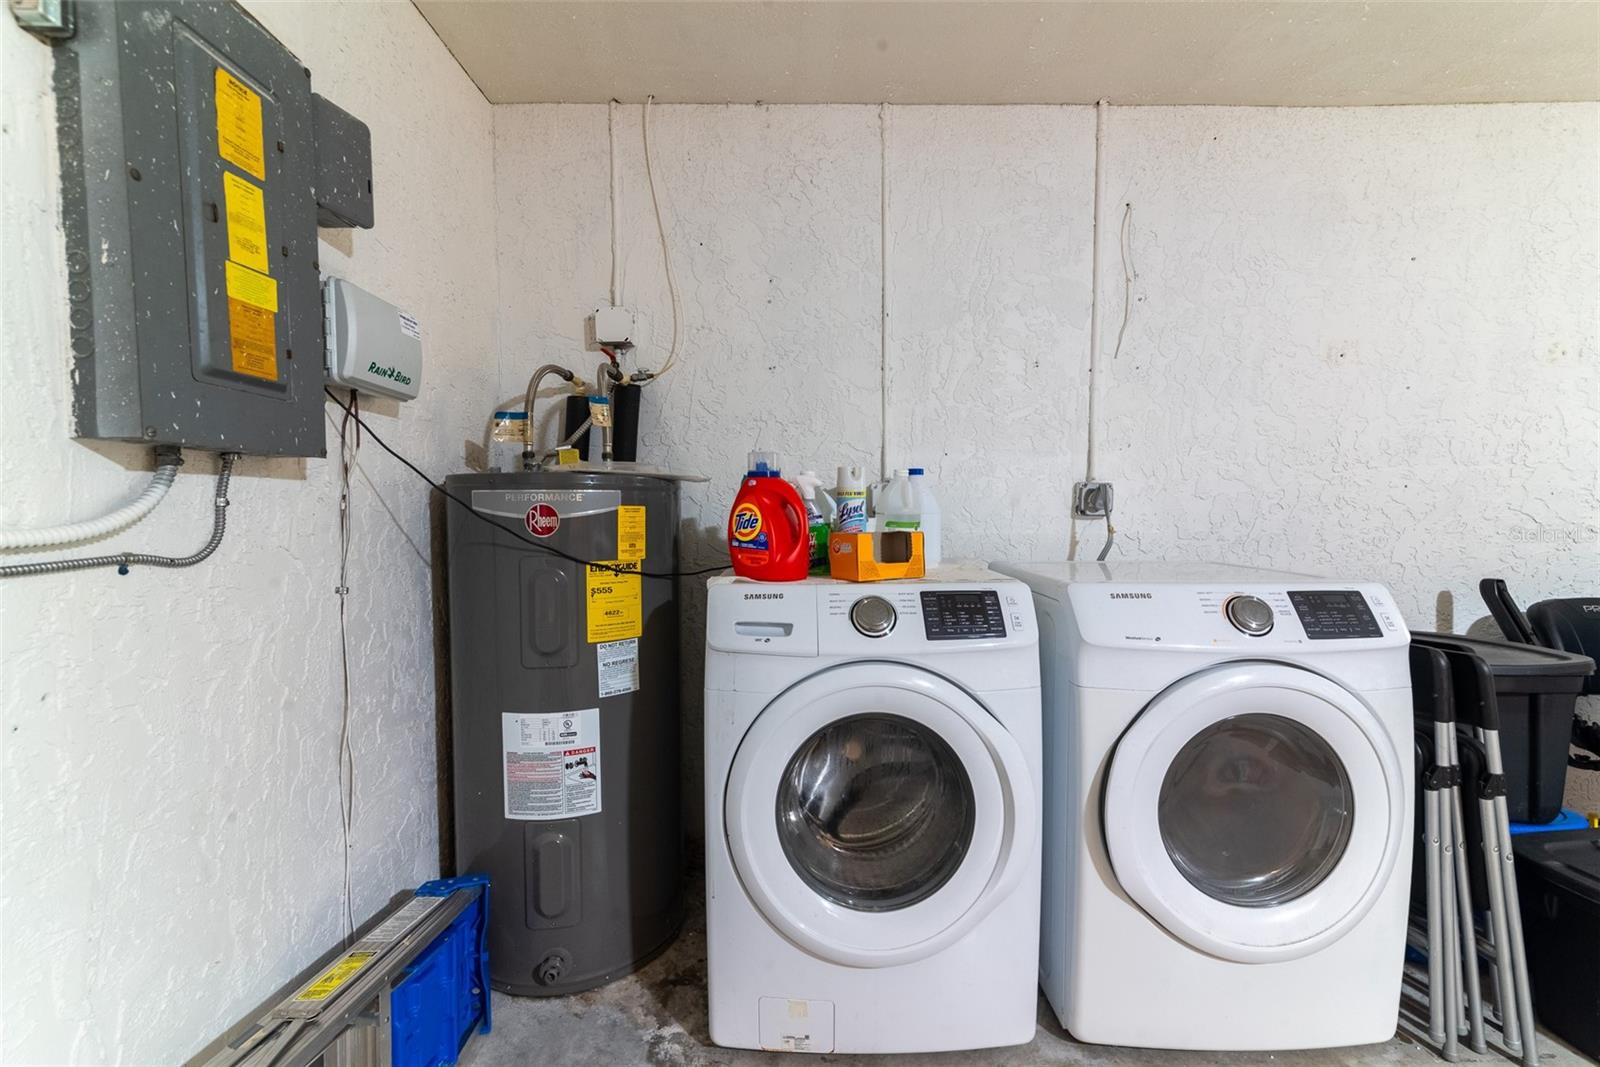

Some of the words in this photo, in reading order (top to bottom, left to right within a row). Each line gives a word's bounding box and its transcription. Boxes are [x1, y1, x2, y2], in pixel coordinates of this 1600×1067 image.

[368, 361, 389, 377] RAIN
[394, 371, 412, 386] BIRD
[505, 493, 583, 502] PERFORMANCE
[529, 504, 558, 532] Rheem
[839, 500, 864, 520] Lysol
[735, 512, 759, 533] Tide
[591, 587, 613, 595] $555
[571, 747, 595, 755] DANGER
